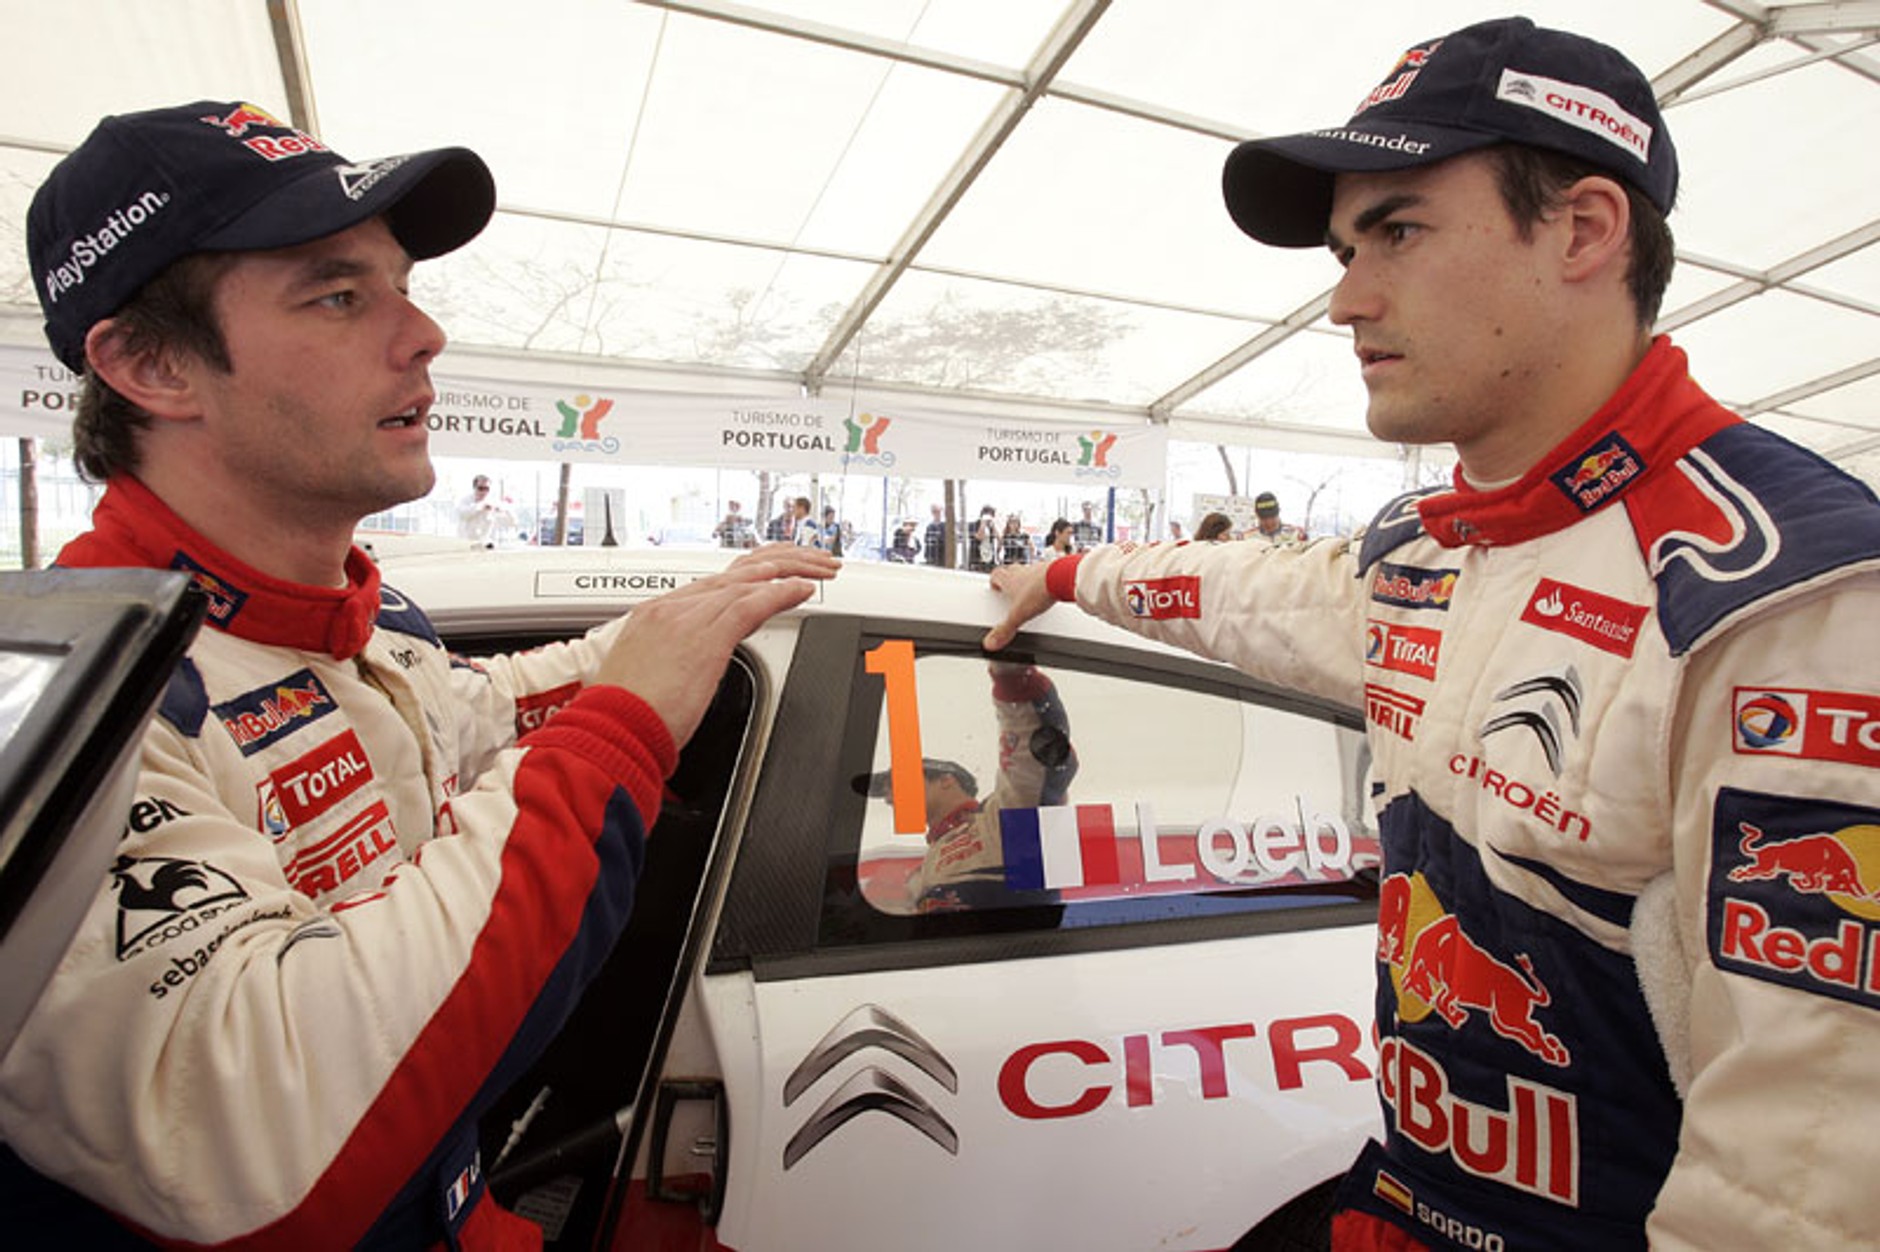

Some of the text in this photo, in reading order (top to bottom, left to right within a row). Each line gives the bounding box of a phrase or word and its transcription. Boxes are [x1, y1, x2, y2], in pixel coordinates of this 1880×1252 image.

[46, 191, 164, 302] PlayStation
[427, 413, 546, 437] ORTUGAL
[507, 396, 531, 411] DE
[733, 411, 824, 428] TURISMO DE
[723, 430, 836, 452] PORTUGAL
[978, 446, 1071, 465] PORTUGAL
[987, 428, 1061, 443] TURISMO DE
[865, 640, 926, 834] 1
[282, 752, 366, 807] TOTAL
[1136, 795, 1352, 884] Loeb
[1720, 897, 1866, 990] Red
[997, 1013, 1378, 1119] CITR
[1396, 1036, 1580, 1208] Bull
[1417, 1203, 1505, 1252] SORDO
